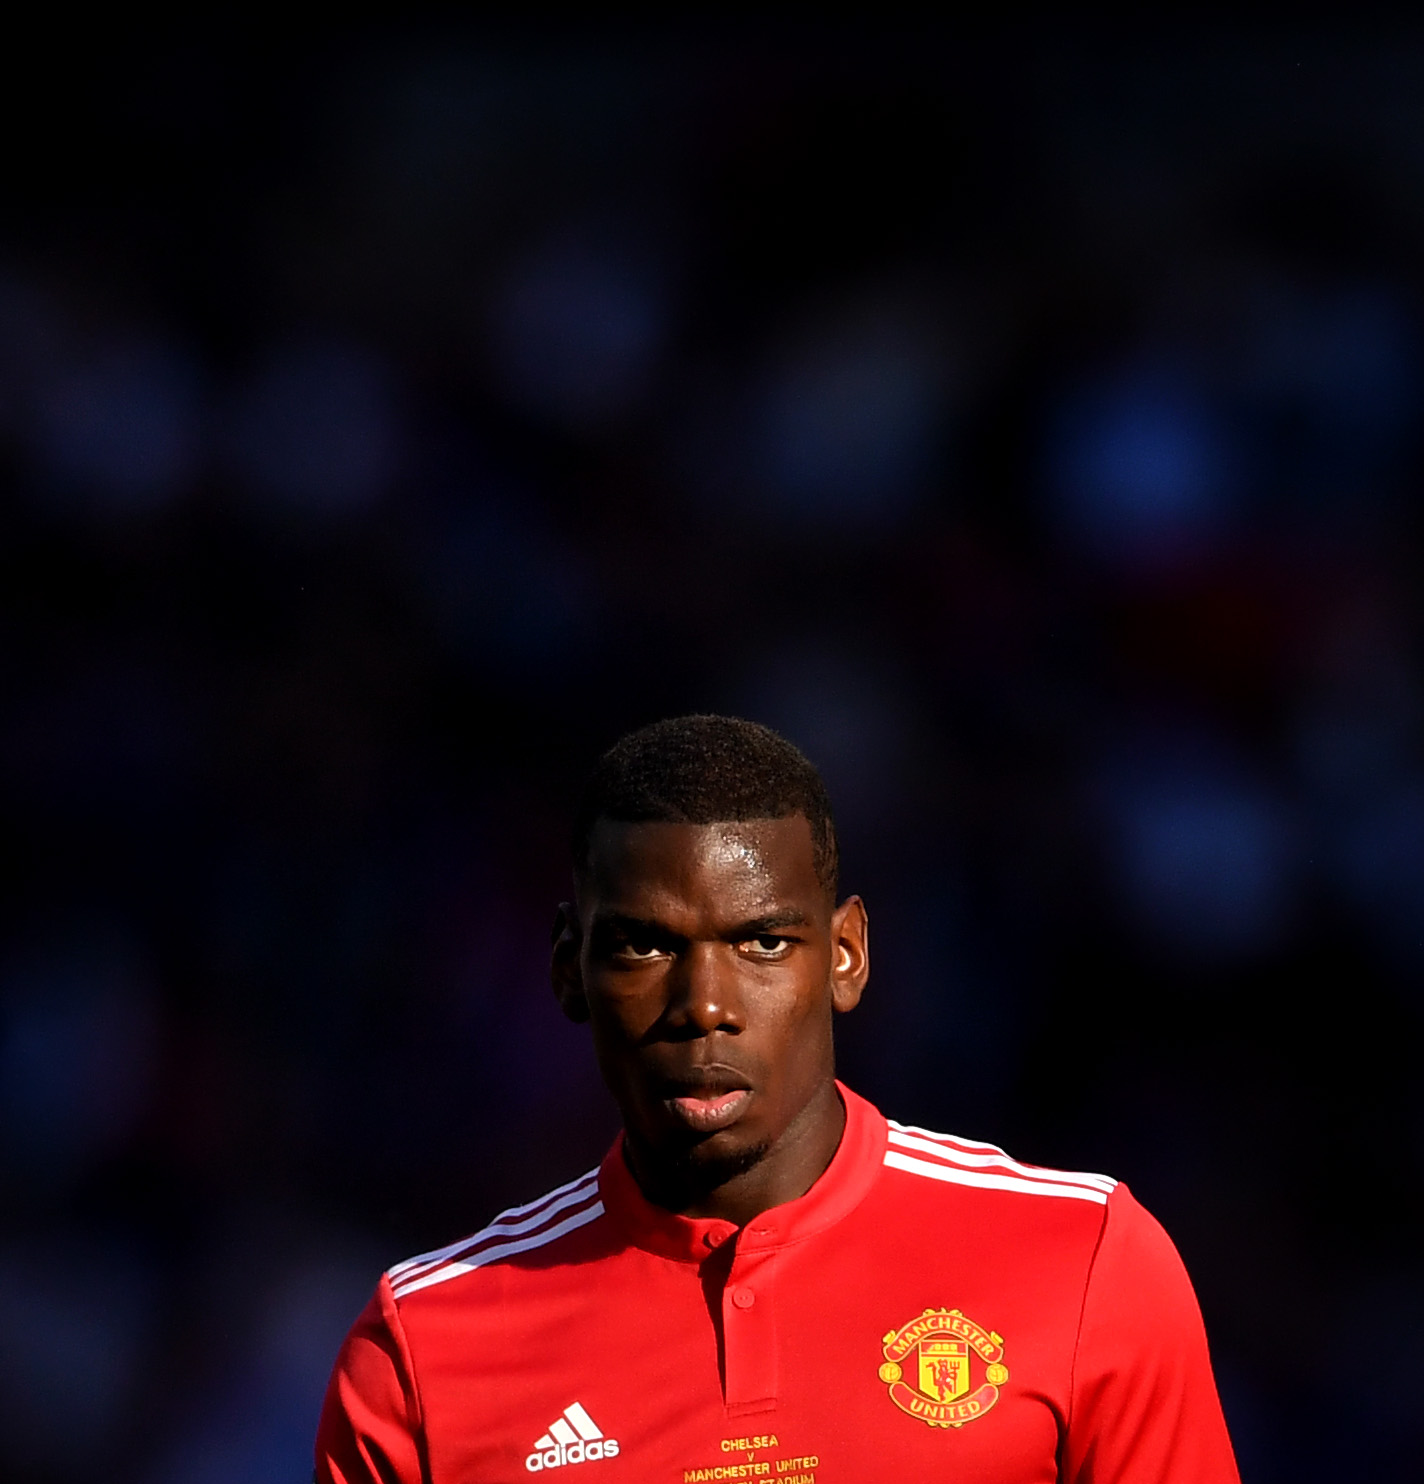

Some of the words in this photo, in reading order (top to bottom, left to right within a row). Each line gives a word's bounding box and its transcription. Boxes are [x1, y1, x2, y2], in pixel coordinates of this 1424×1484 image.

[892, 1317, 995, 1356] MANCHESTER
[910, 1398, 981, 1419] UNITED
[525, 1439, 620, 1472] adidas
[721, 1434, 779, 1452] CHELSEA
[684, 1462, 770, 1483] MANCHESTER
[776, 1456, 819, 1472] UNITED
